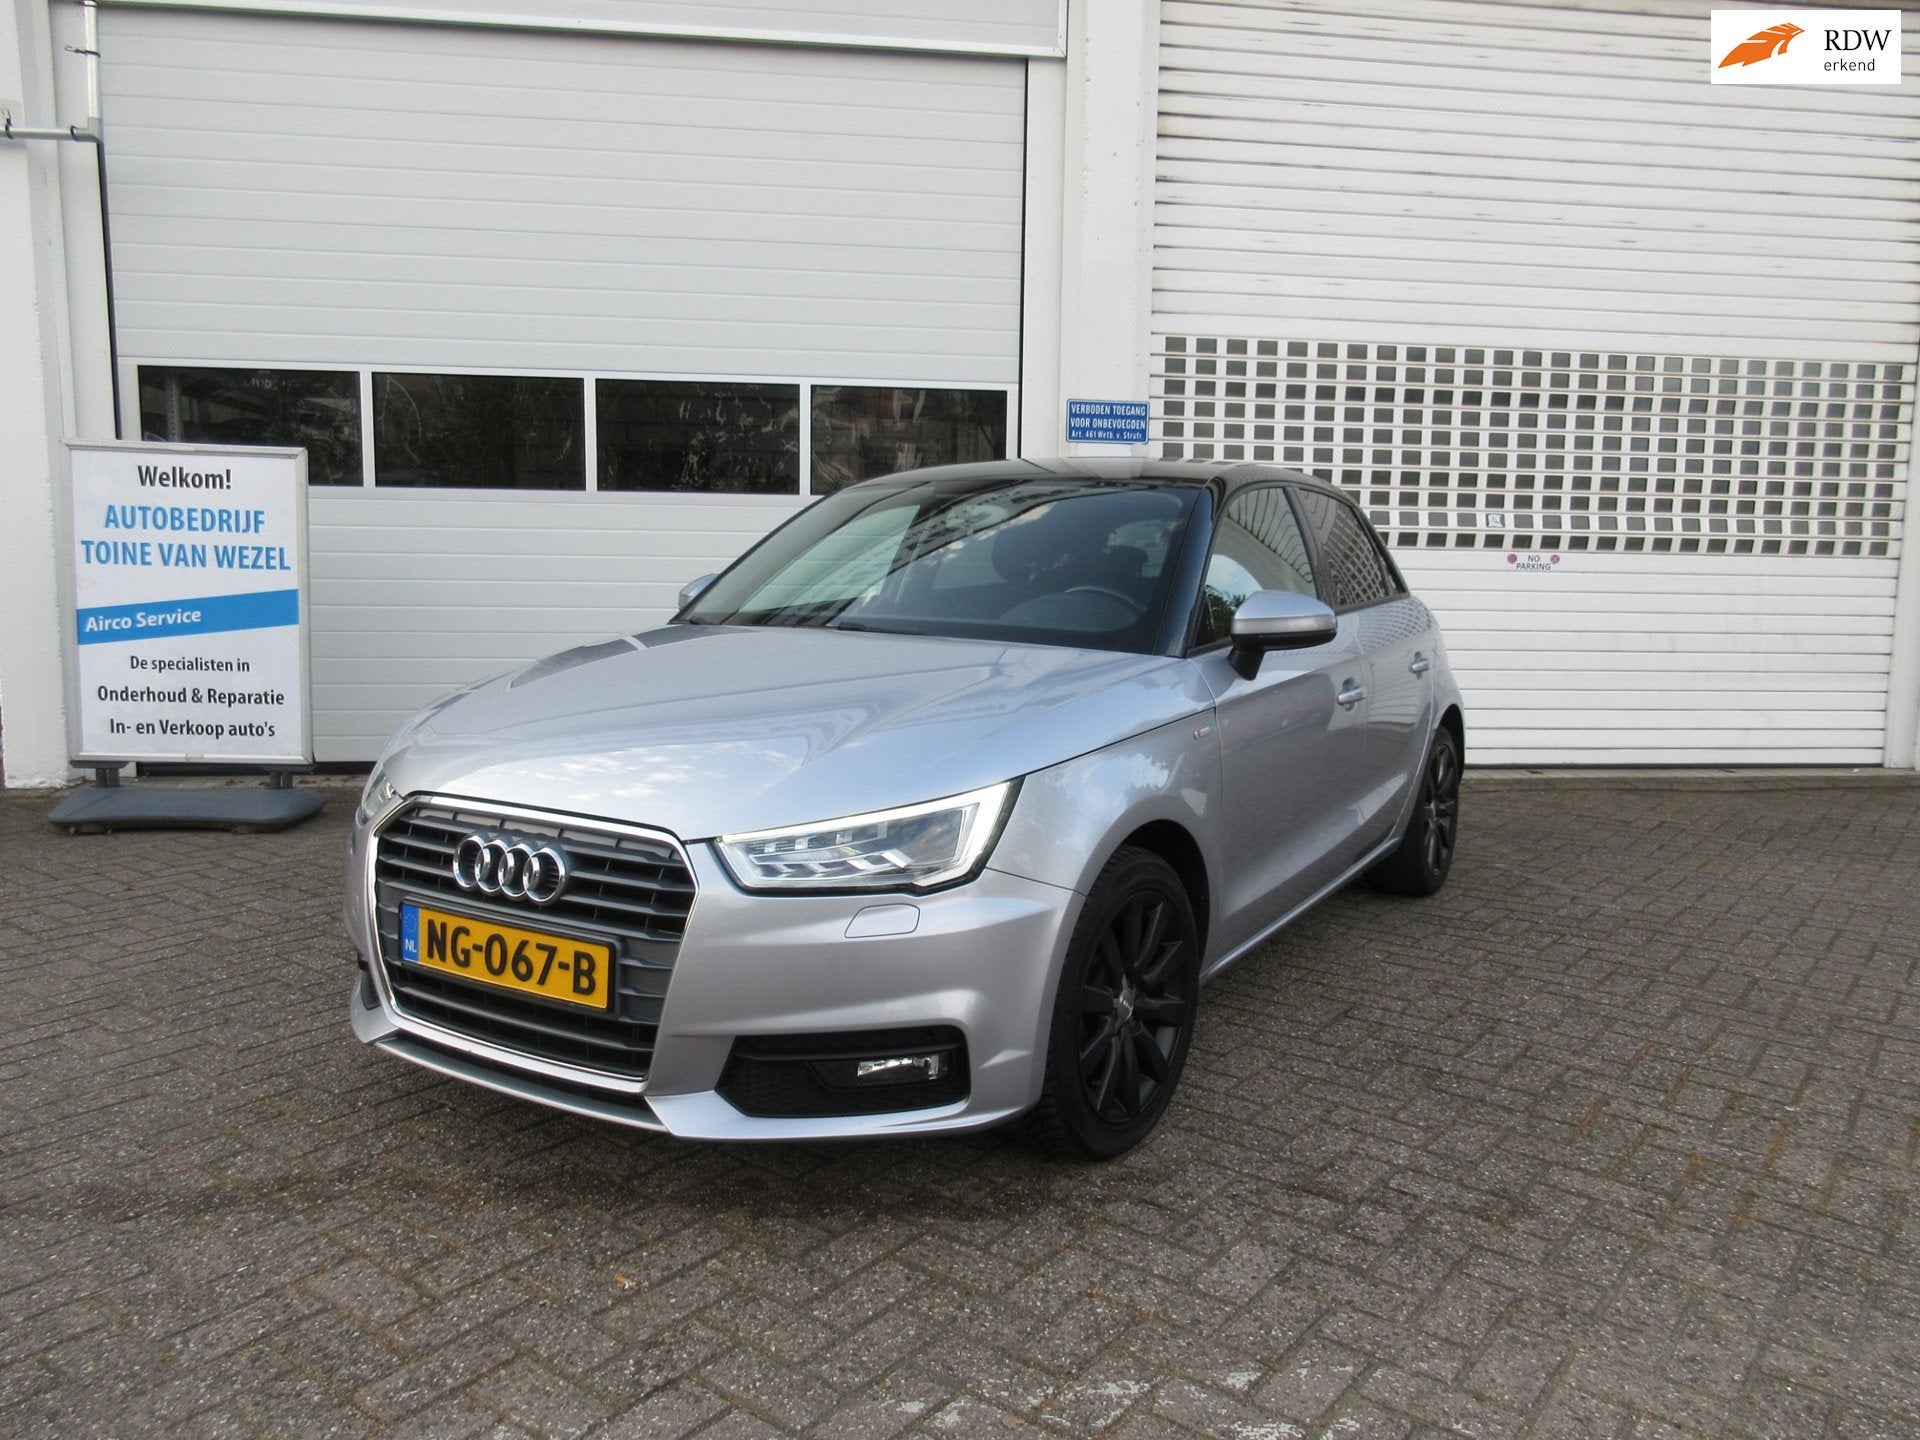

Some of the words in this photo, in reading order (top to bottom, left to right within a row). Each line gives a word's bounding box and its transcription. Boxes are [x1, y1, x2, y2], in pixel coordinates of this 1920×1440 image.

[1071, 404, 1110, 415] VERBODEN
[1113, 405, 1146, 416] TOEGANG
[1070, 418, 1090, 427] VOOR
[1092, 418, 1145, 429] ONBEVOEGDEN
[1071, 430, 1083, 438] Art.
[1086, 430, 1097, 438] 461
[137, 465, 232, 490] Welkom!
[104, 504, 265, 534] AUTOBEDRIJF
[81, 540, 152, 566] TOINE
[158, 542, 207, 568] VAN
[214, 545, 291, 571] WEZEL
[1516, 562, 1551, 570] PARKING
[85, 616, 132, 633] Airco
[136, 609, 201, 628] Service
[130, 655, 148, 670] De
[151, 657, 233, 673] specialisten
[237, 658, 250, 672] in
[98, 685, 187, 703] Onderhoud
[191, 688, 203, 704] &
[207, 688, 285, 708] Reparatie
[110, 718, 132, 734] In-
[136, 722, 155, 735] en
[159, 720, 224, 740] Verkoop
[228, 722, 275, 737] auto's
[405, 938, 417, 953] NL
[426, 918, 596, 996] NG-067-B
